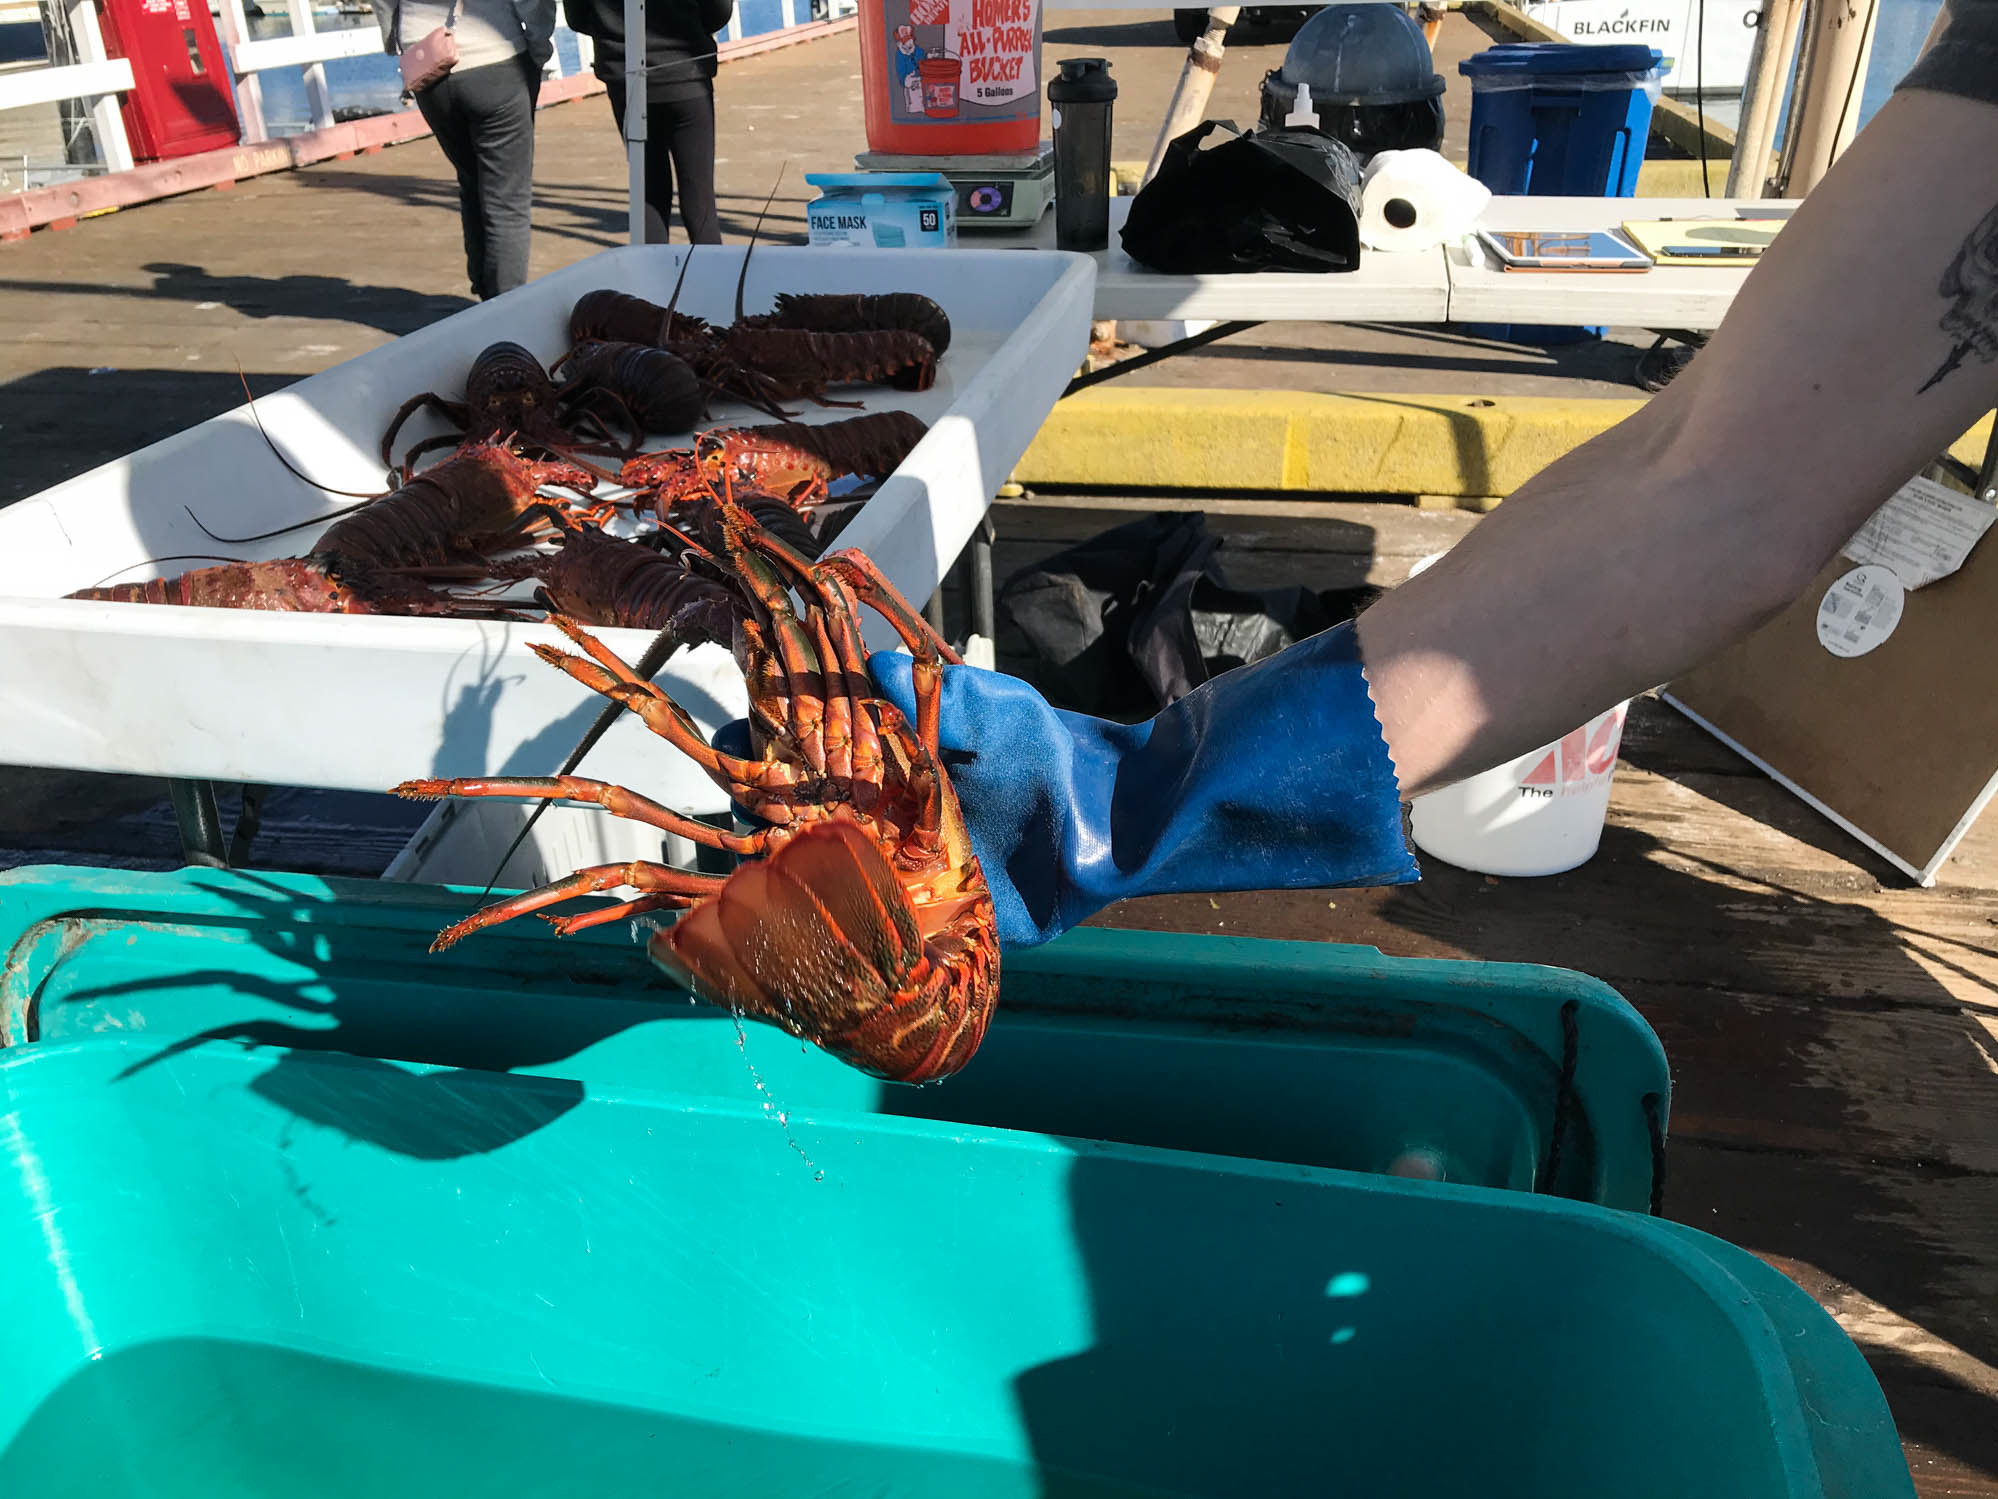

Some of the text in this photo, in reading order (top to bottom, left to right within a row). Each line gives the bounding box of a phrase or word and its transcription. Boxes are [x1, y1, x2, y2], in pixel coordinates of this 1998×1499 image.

[1574, 19, 1670, 34] BLACKFIN
[970, 56, 1023, 84] BUCKET
[977, 87, 1013, 97] 5 Gallons
[811, 216, 867, 229] FACE MASK
[923, 213, 936, 226] 50
[1518, 786, 1553, 797] The
